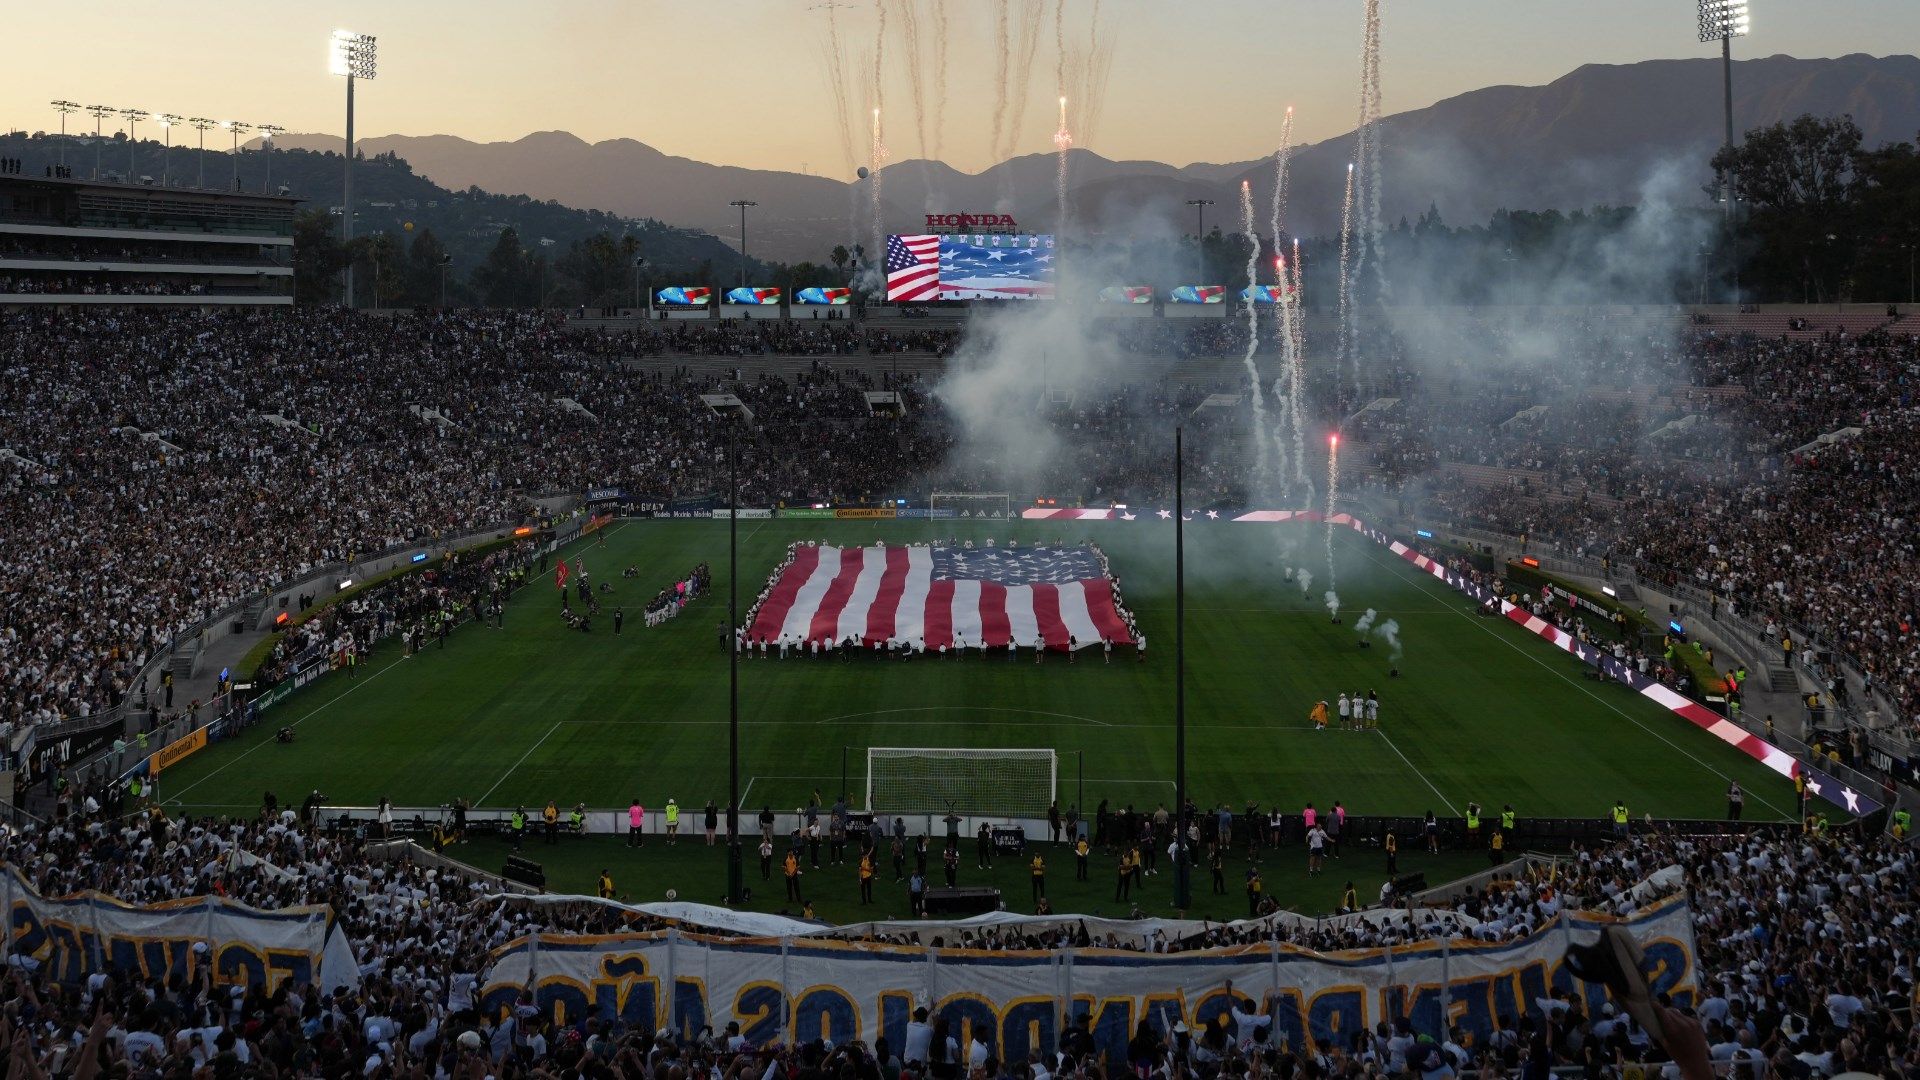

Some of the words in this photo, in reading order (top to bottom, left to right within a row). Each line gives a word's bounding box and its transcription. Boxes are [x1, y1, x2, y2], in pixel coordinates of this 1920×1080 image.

[925, 214, 1017, 226] HONDA
[836, 510, 872, 518] Continental
[159, 737, 193, 767] Continental
